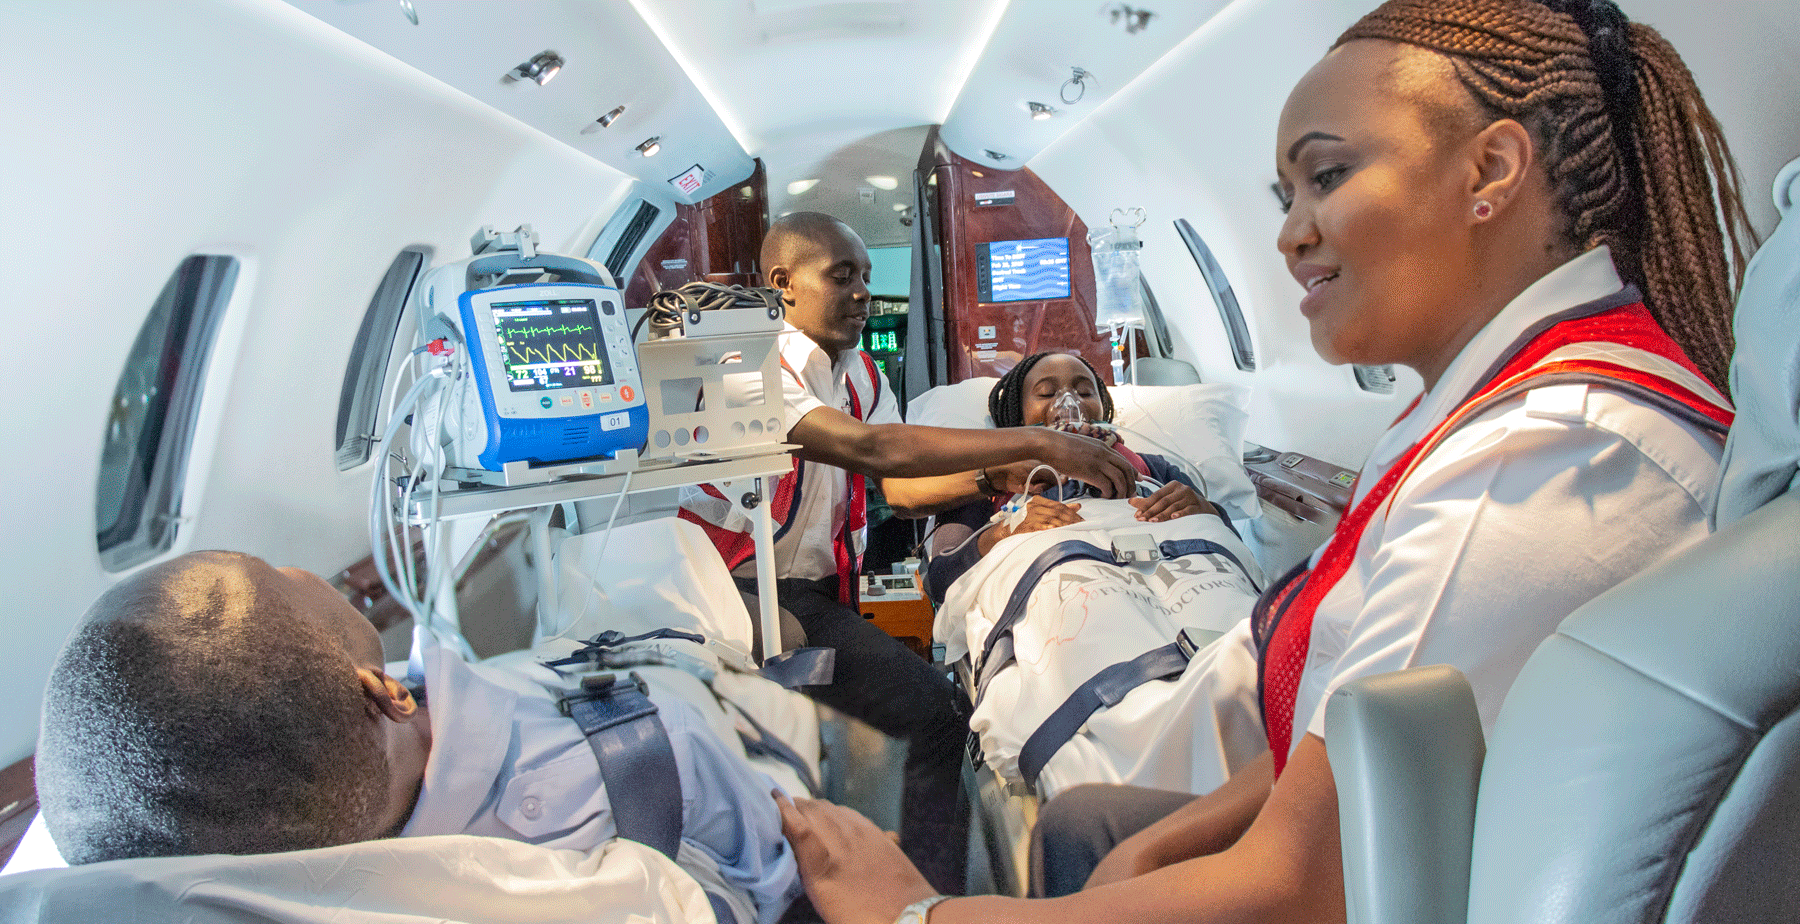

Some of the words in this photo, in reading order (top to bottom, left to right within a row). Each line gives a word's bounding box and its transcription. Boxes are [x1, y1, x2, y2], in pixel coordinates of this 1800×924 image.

[679, 173, 701, 193] EXIT
[539, 289, 558, 297] ZOLL
[515, 370, 529, 379] 72
[564, 366, 576, 376] 21
[609, 417, 621, 427] 01
[1159, 579, 1236, 617] DOCTORS
